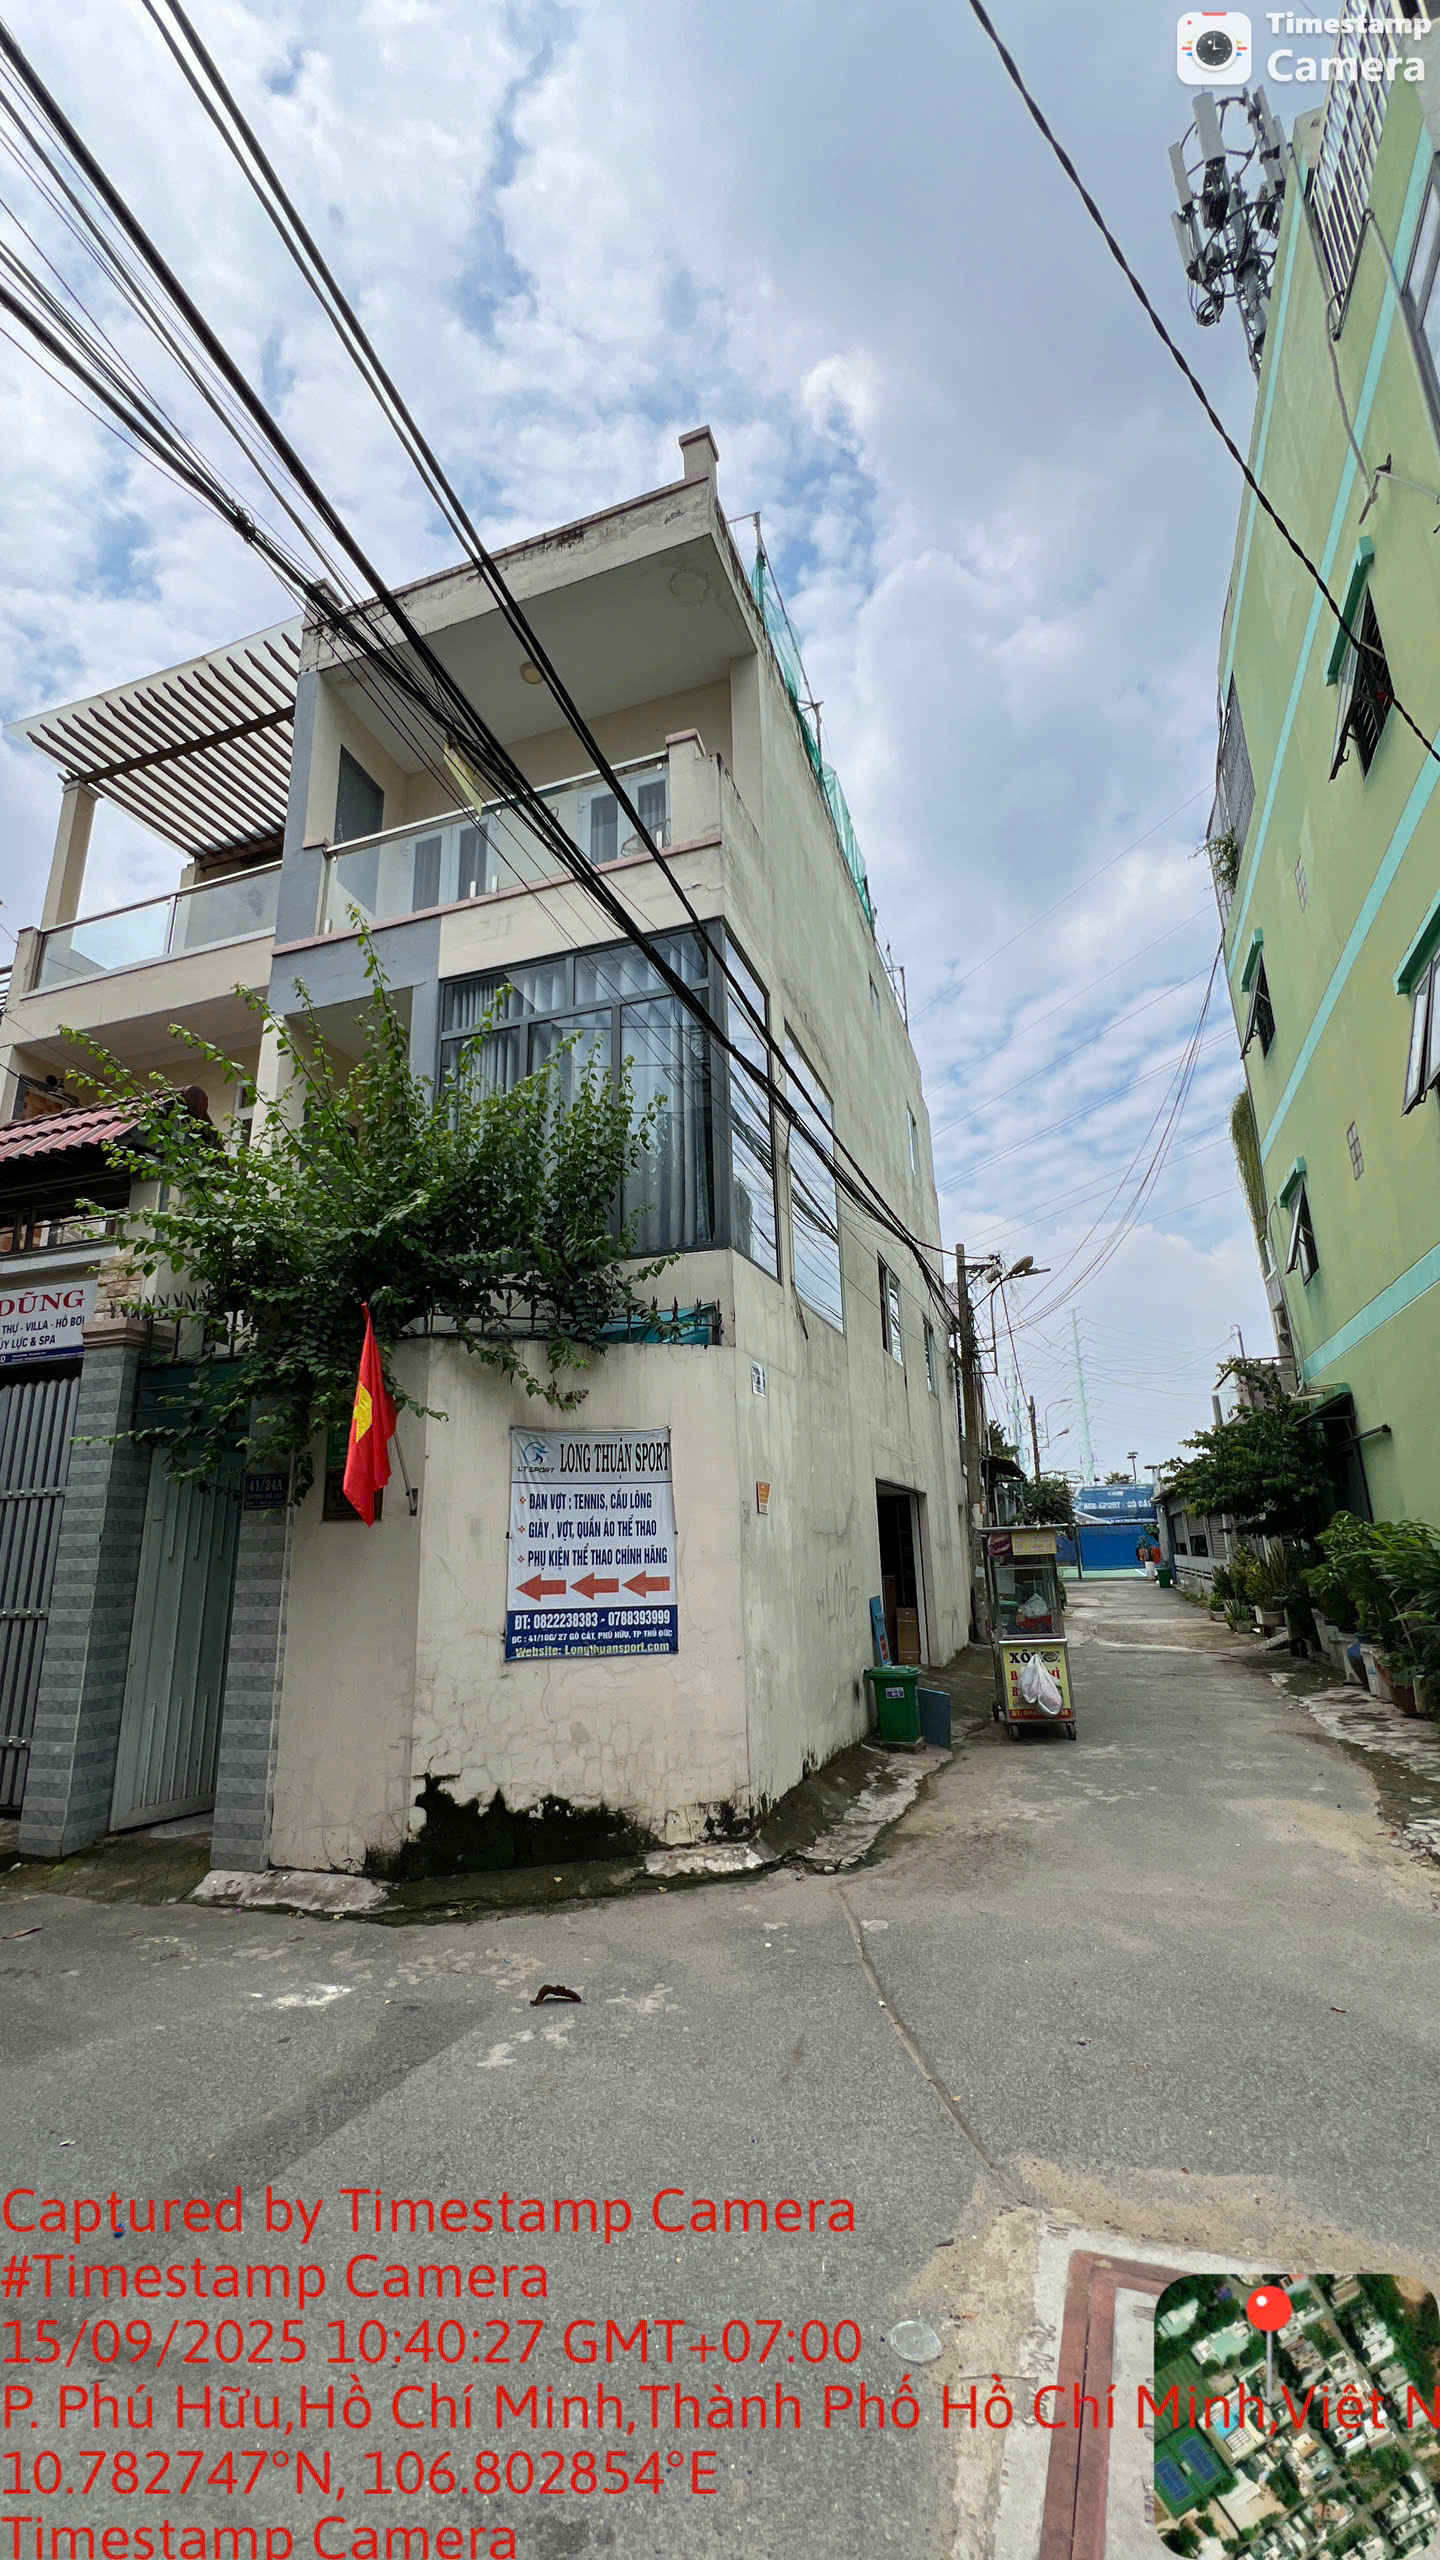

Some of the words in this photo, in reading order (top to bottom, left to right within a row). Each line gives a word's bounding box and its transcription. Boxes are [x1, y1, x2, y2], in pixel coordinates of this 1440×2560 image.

[0, 1289, 85, 1317] DŨNG
[26, 1320, 48, 1331] VILLA
[30, 1337, 36, 1346] &
[39, 1335, 55, 1346] SPA
[560, 1443, 591, 1473] LONG
[594, 1437, 632, 1479] THUẬN
[635, 1442, 670, 1472] SPORT
[550, 1492, 566, 1513] VỢT
[574, 1493, 608, 1511] TENNIS,
[630, 1489, 652, 1508] LÔNG
[603, 1517, 615, 1537] ÁO
[635, 1519, 657, 1537] THAO
[528, 1550, 546, 1571] PHỤ
[549, 1546, 570, 1570] KIỆN
[591, 1549, 613, 1565] THAO
[615, 1545, 642, 1565] CHÍNH
[514, 1614, 531, 1631] ĐT:
[534, 1612, 599, 1629] 0822238383
[608, 1609, 671, 1627] 0788393999
[633, 1630, 642, 1638] TP
[515, 1645, 562, 1658] Website:
